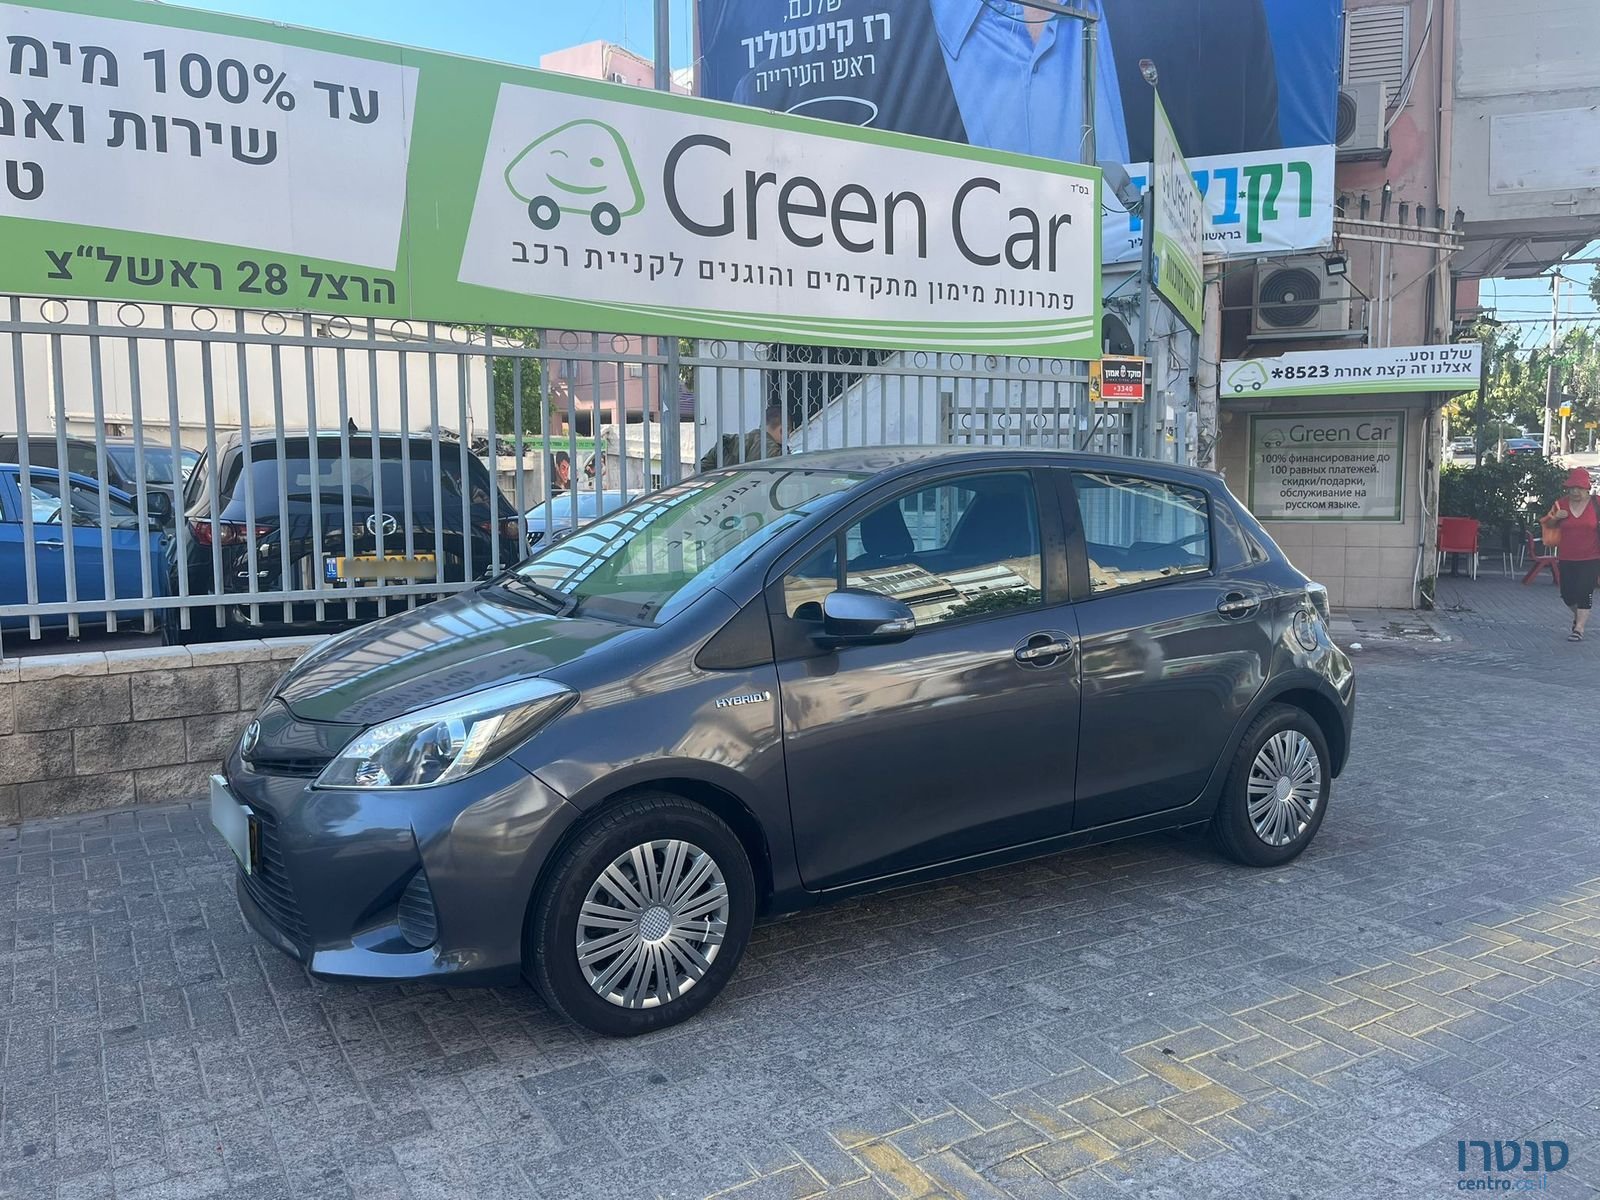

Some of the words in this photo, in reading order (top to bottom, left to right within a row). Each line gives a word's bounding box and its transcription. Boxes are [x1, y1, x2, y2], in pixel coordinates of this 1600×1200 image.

[862, 12, 892, 43] רז
[741, 18, 854, 69] קינסטליך
[756, 61, 824, 93] העירייה
[832, 54, 876, 81] ראש
[144, 49, 295, 112] 100%
[314, 81, 378, 124] עד
[107, 109, 278, 166] שירות
[663, 134, 926, 258] Green
[952, 178, 1071, 272] Car
[1202, 229, 1241, 241] בראשו
[512, 241, 569, 267] רכב
[584, 252, 684, 281] לקניית
[237, 261, 288, 296] 28
[301, 264, 395, 304] הרצל
[699, 259, 793, 287] והוגנים
[807, 270, 917, 299] מתקדמים
[928, 281, 985, 304] מימון
[994, 287, 1074, 311] פתרונות
[1440, 348, 1472, 360] שלם
[1334, 366, 1372, 378] אחרת
[1376, 364, 1406, 377] קצת
[1411, 364, 1427, 375] זה
[1431, 361, 1472, 374] אצלנו
[1289, 424, 1350, 442] Green
[1356, 423, 1392, 441] Car
[1261, 454, 1287, 463] 100%
[1288, 453, 1375, 464] финансирование
[1376, 454, 1390, 464] до
[1271, 465, 1287, 475] 100
[1289, 467, 1326, 476] равных
[1328, 465, 1379, 475] платежей.
[1280, 488, 1352, 499] обслуживание
[1355, 490, 1367, 498] на
[1285, 501, 1326, 511] русском
[1328, 501, 1360, 510] языке.
[716, 694, 763, 708] HYBRID
